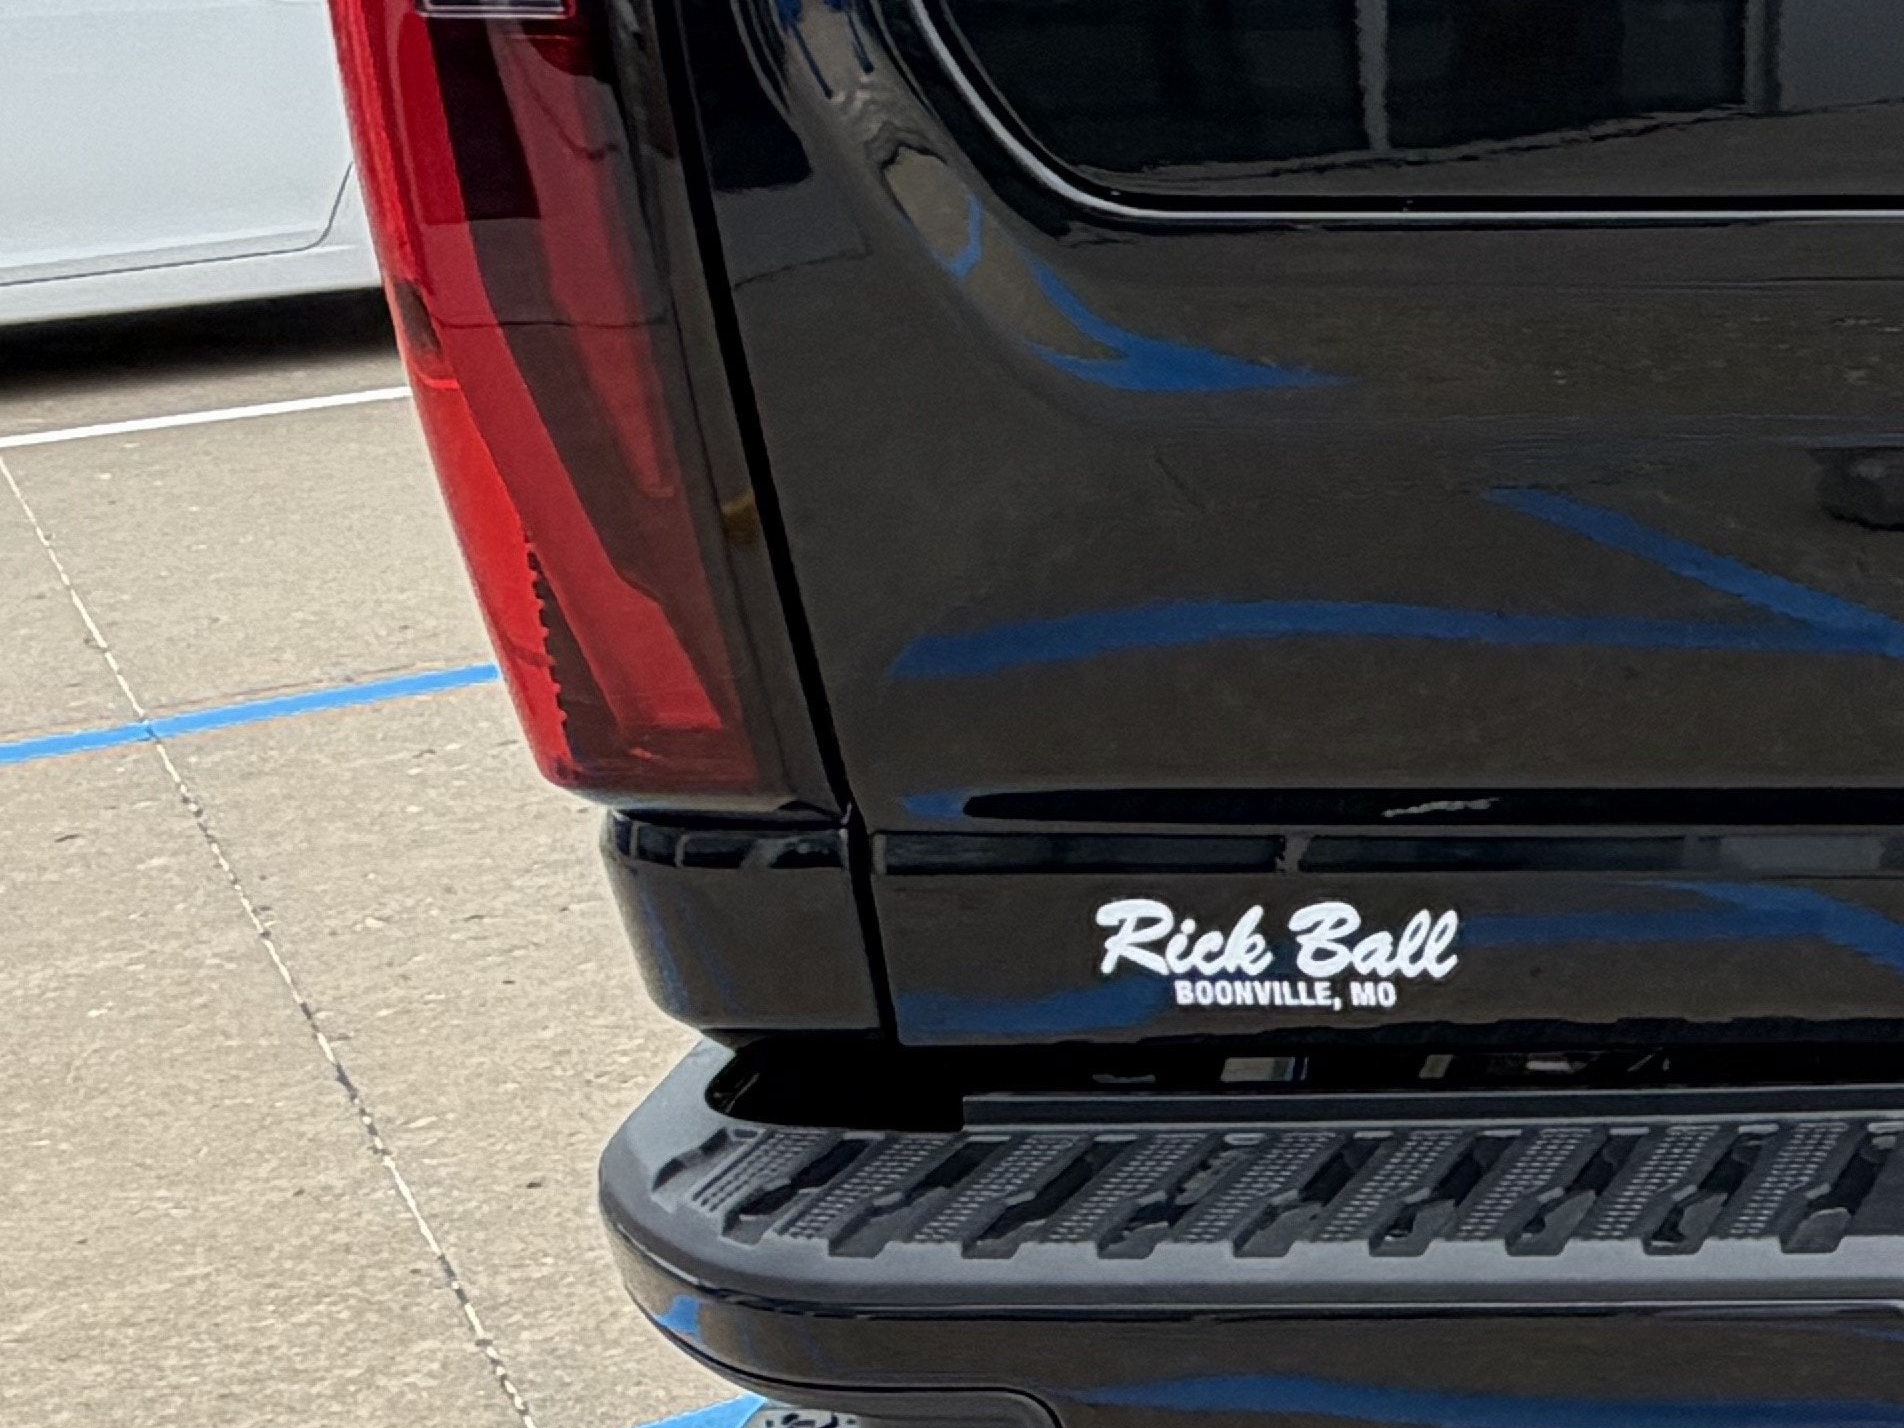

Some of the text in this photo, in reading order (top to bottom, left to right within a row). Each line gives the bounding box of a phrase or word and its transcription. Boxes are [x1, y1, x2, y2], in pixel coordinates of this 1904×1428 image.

[1096, 898, 1459, 979] Rick Ball
[1174, 979, 1397, 1012] BOONVILLE, MO
